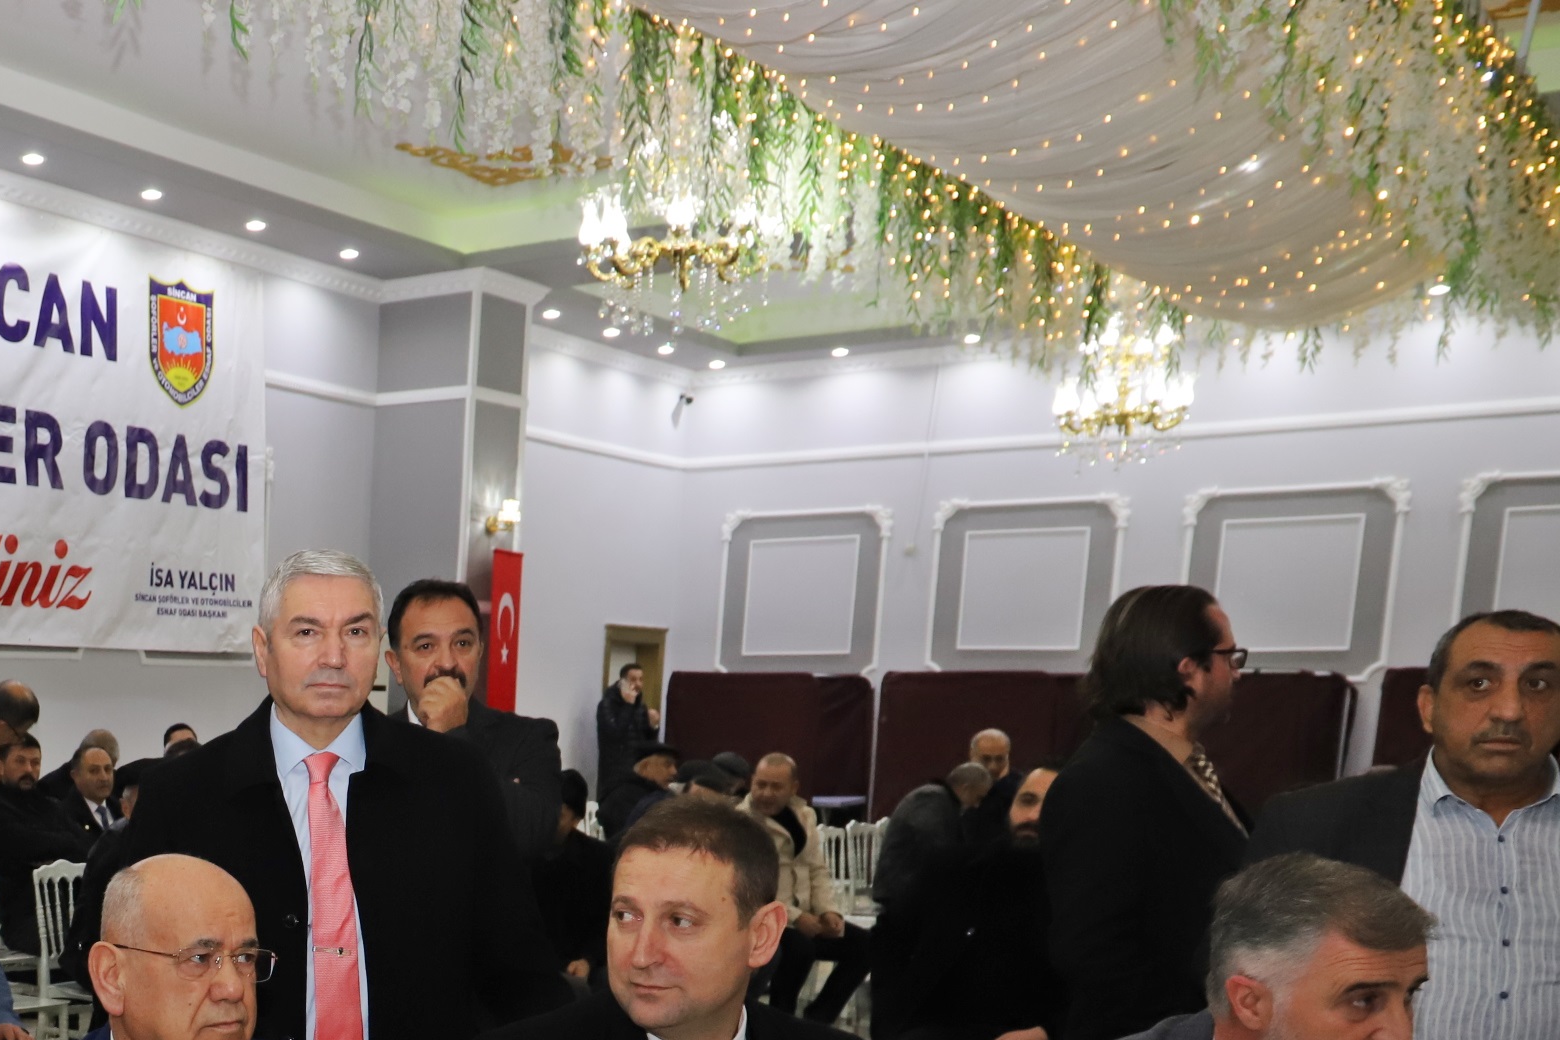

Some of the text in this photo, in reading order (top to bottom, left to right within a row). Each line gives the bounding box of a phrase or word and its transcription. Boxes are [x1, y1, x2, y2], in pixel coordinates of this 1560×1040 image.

[167, 286, 197, 302] SİNCAN
[82, 418, 249, 513] ODASI
[149, 562, 235, 596] İSA YALÇIN
[191, 597, 199, 605] VE
